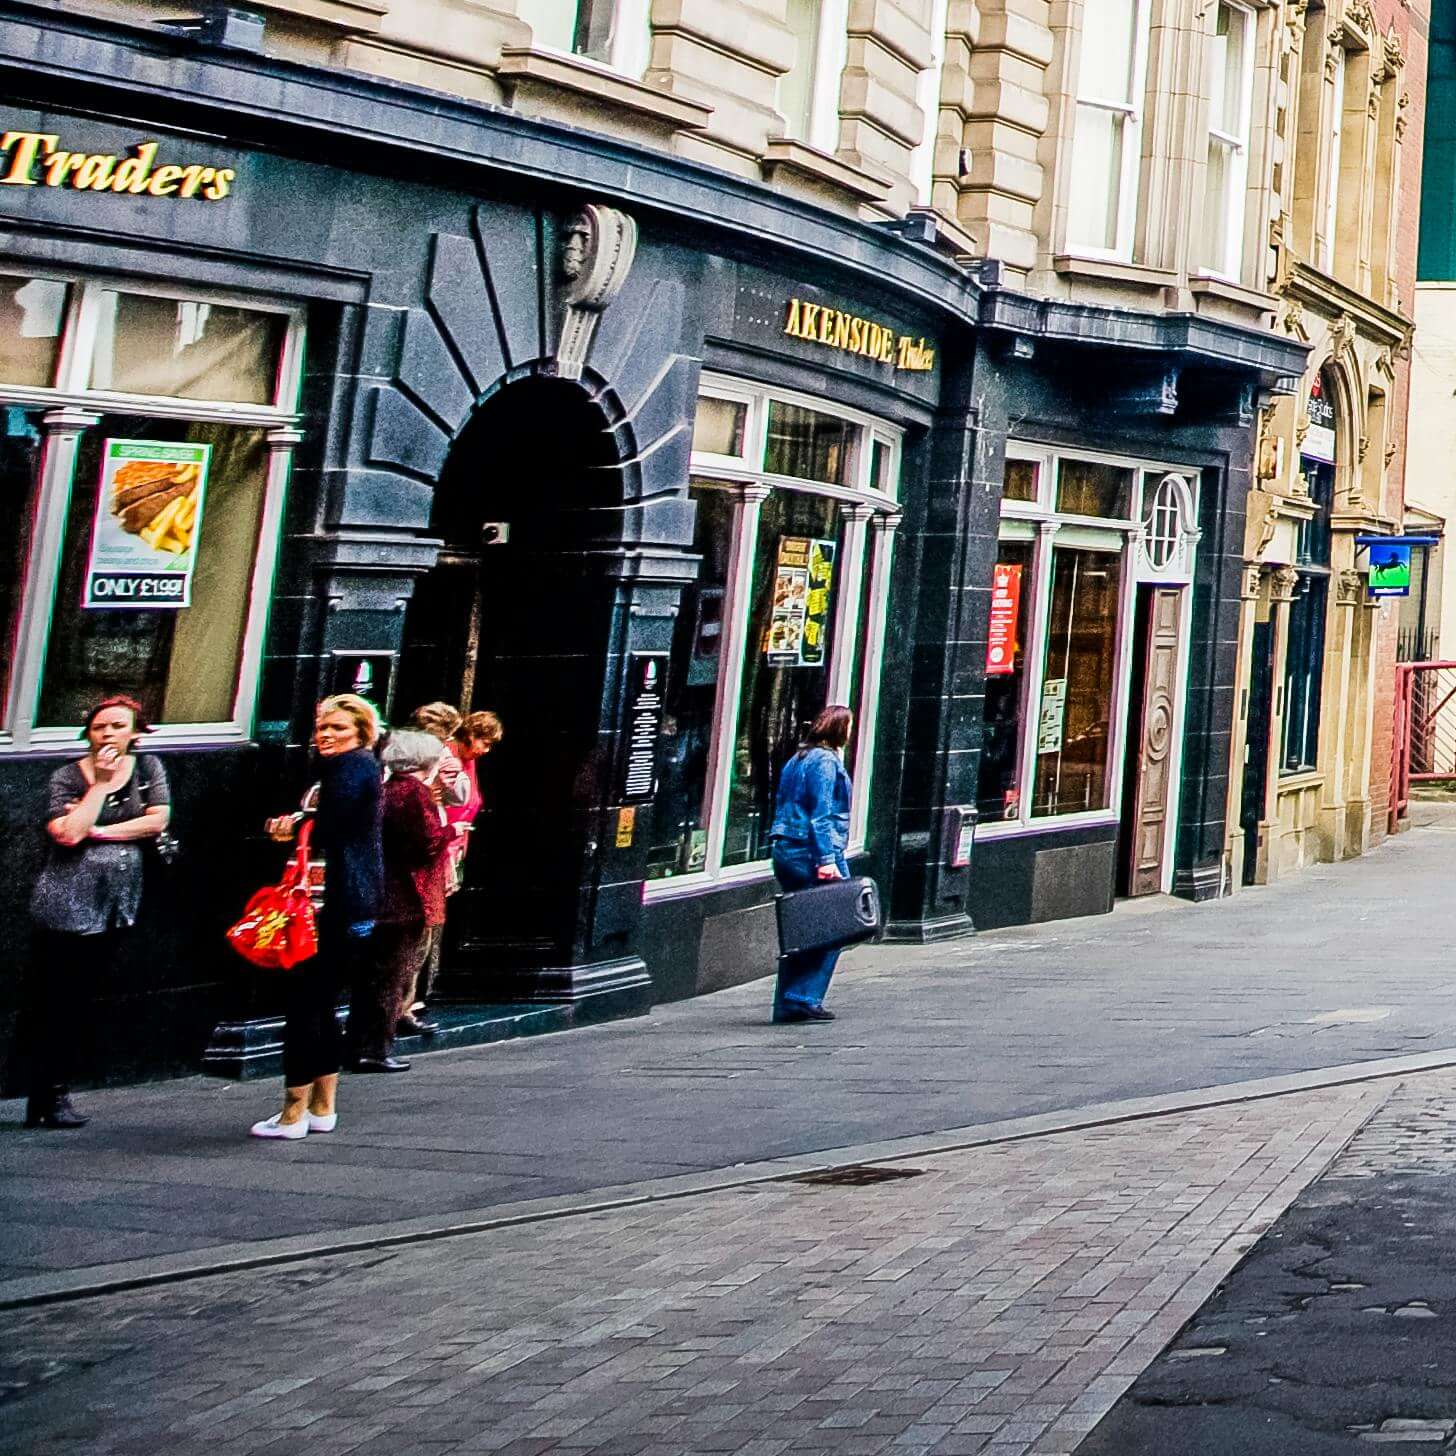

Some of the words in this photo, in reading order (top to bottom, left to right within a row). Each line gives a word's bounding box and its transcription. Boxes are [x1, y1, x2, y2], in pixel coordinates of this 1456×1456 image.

[0, 132, 236, 201] Traders
[784, 298, 895, 364] AKENSIDE
[94, 578, 139, 597] ONLY
